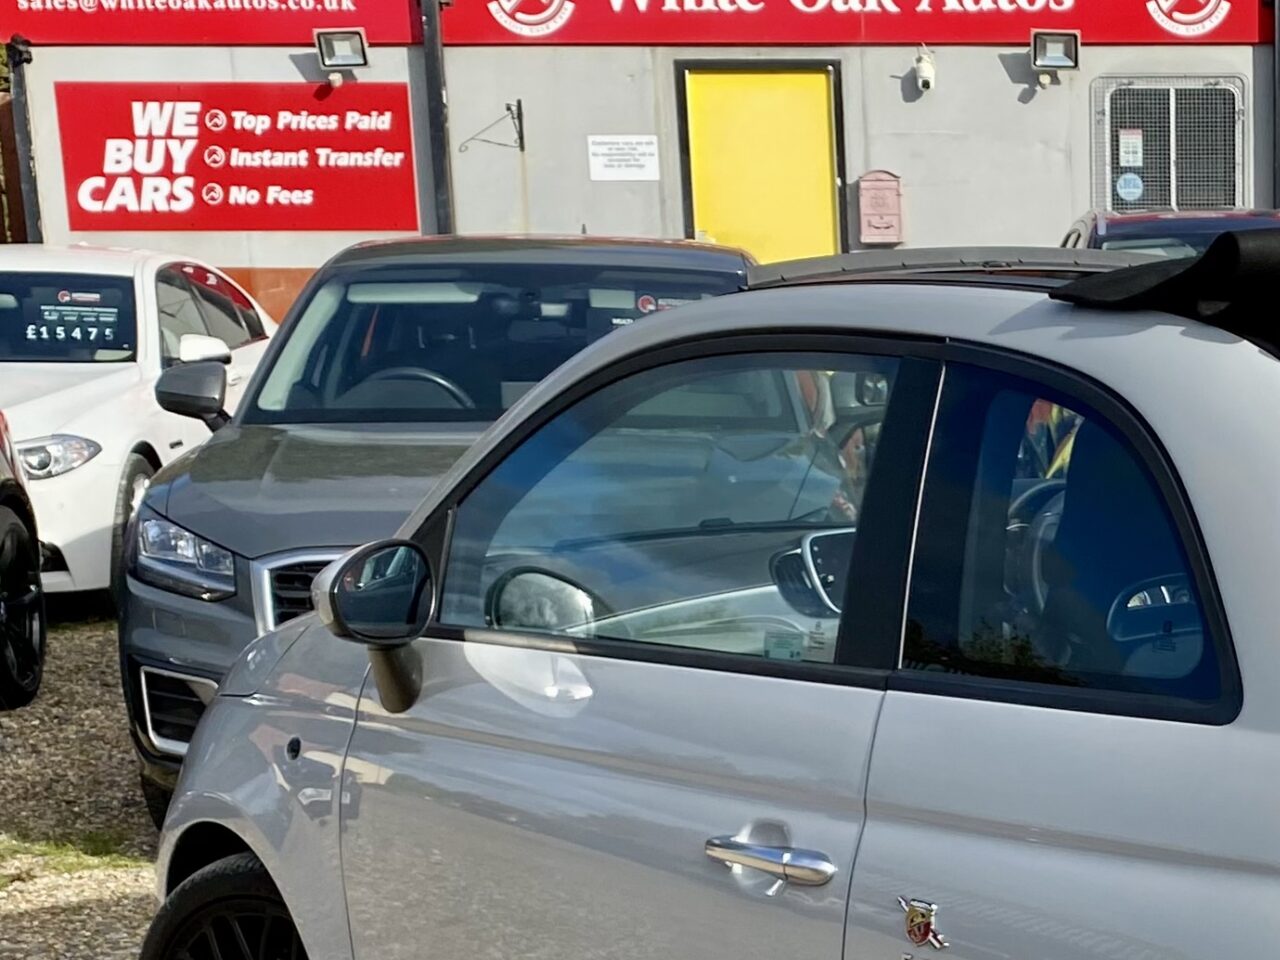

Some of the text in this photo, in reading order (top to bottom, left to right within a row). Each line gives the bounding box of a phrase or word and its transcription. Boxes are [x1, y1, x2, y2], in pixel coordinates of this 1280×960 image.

[131, 102, 202, 137] WE
[231, 110, 392, 133] Top Prices Paid
[103, 139, 198, 174] BUY
[229, 147, 404, 167] Instant Transfer
[77, 176, 195, 212] CARS
[229, 185, 314, 205] No Fees
[26, 324, 114, 341] £15475
